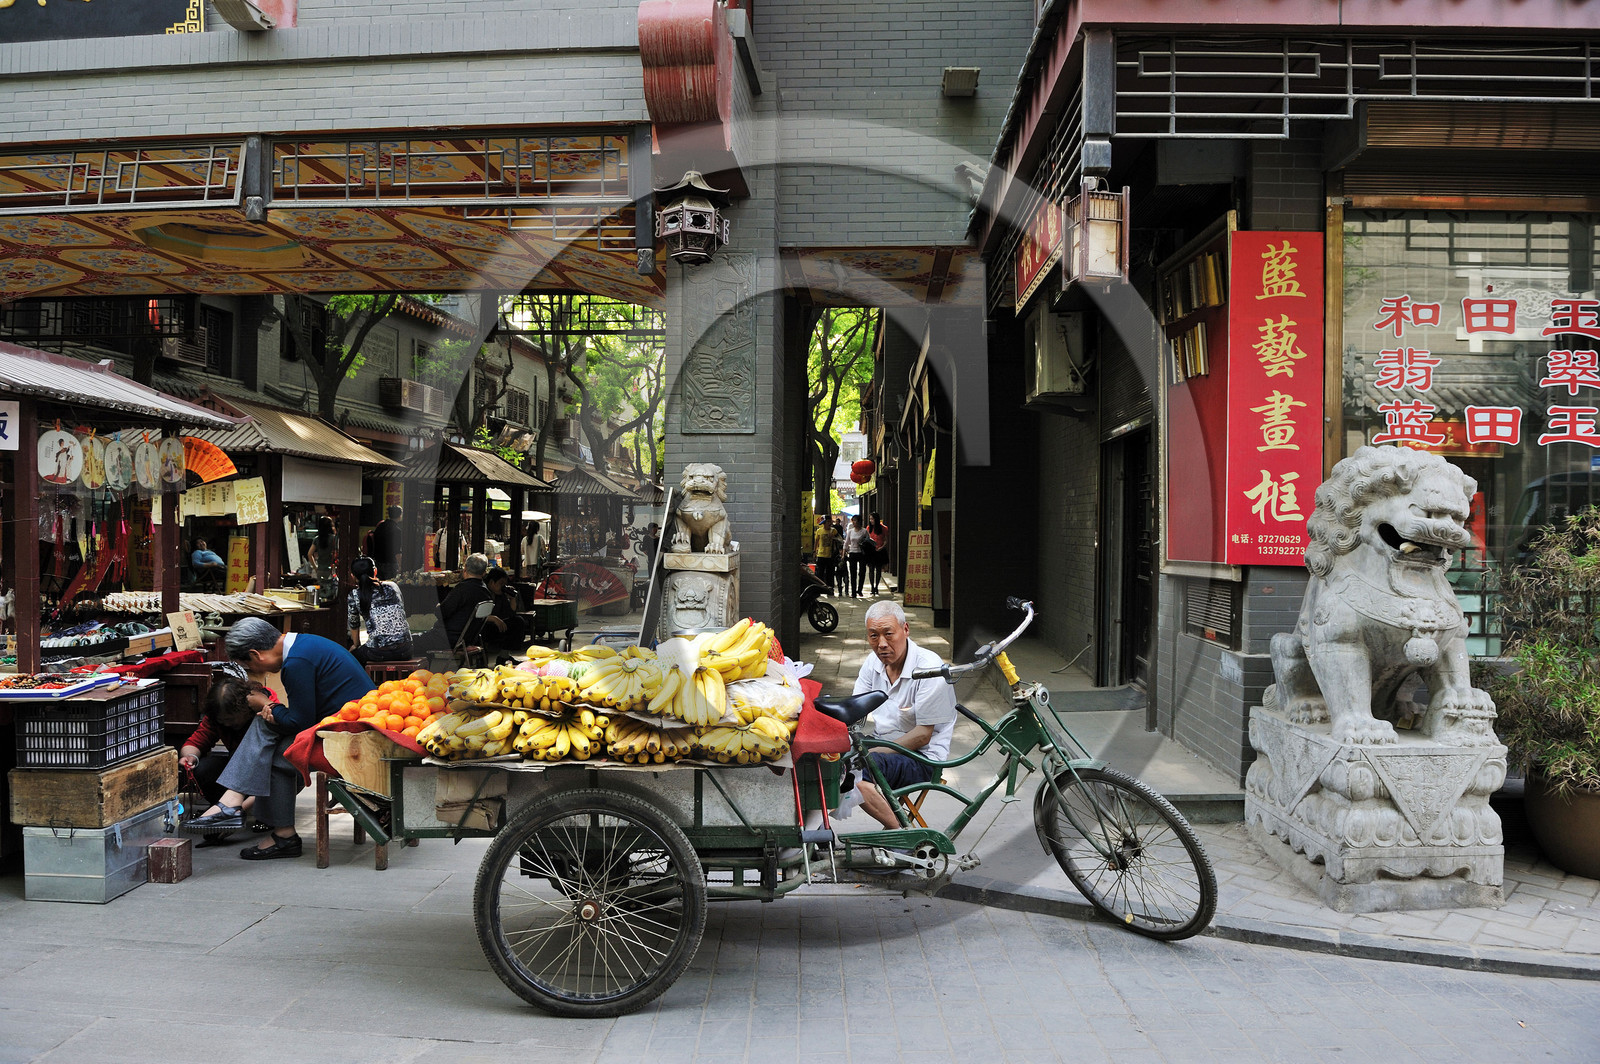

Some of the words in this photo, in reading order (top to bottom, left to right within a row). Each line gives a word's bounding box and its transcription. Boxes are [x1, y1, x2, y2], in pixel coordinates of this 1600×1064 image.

[1373, 294, 1600, 341] 和田玉
[1243, 240, 1308, 524] 藍藝畫框
[1373, 347, 1600, 395] 翡翠
[1372, 399, 1600, 447] 蓝田玉
[909, 534, 932, 546] 厂价直
[1257, 535, 1301, 544] 87270629
[1257, 546, 1306, 555] 133792273
[908, 550, 932, 560] 蓝田玉
